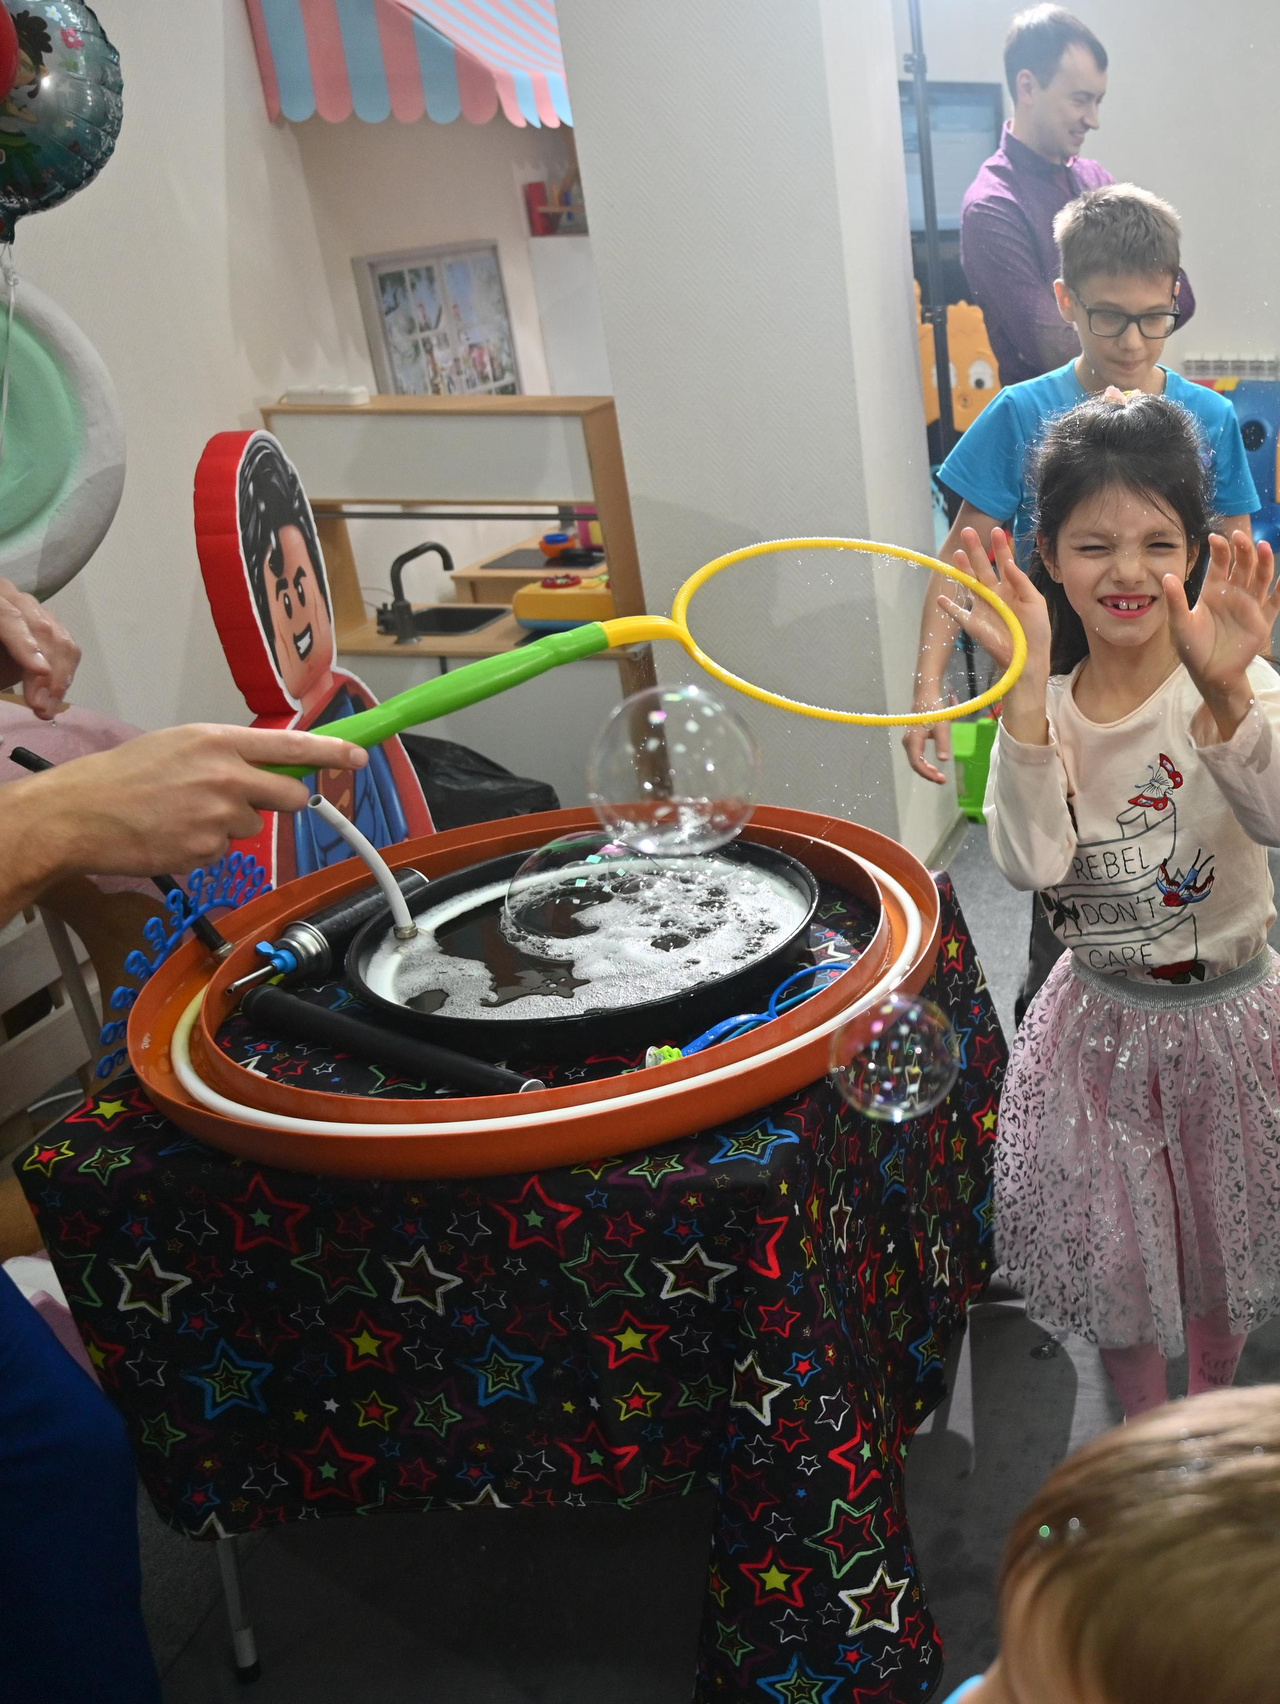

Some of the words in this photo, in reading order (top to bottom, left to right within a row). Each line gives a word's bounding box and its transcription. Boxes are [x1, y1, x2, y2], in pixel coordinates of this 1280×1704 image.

[1073, 846, 1150, 880] REBEL
[1080, 896, 1156, 925] DON'T
[1088, 943, 1153, 970] CARE
